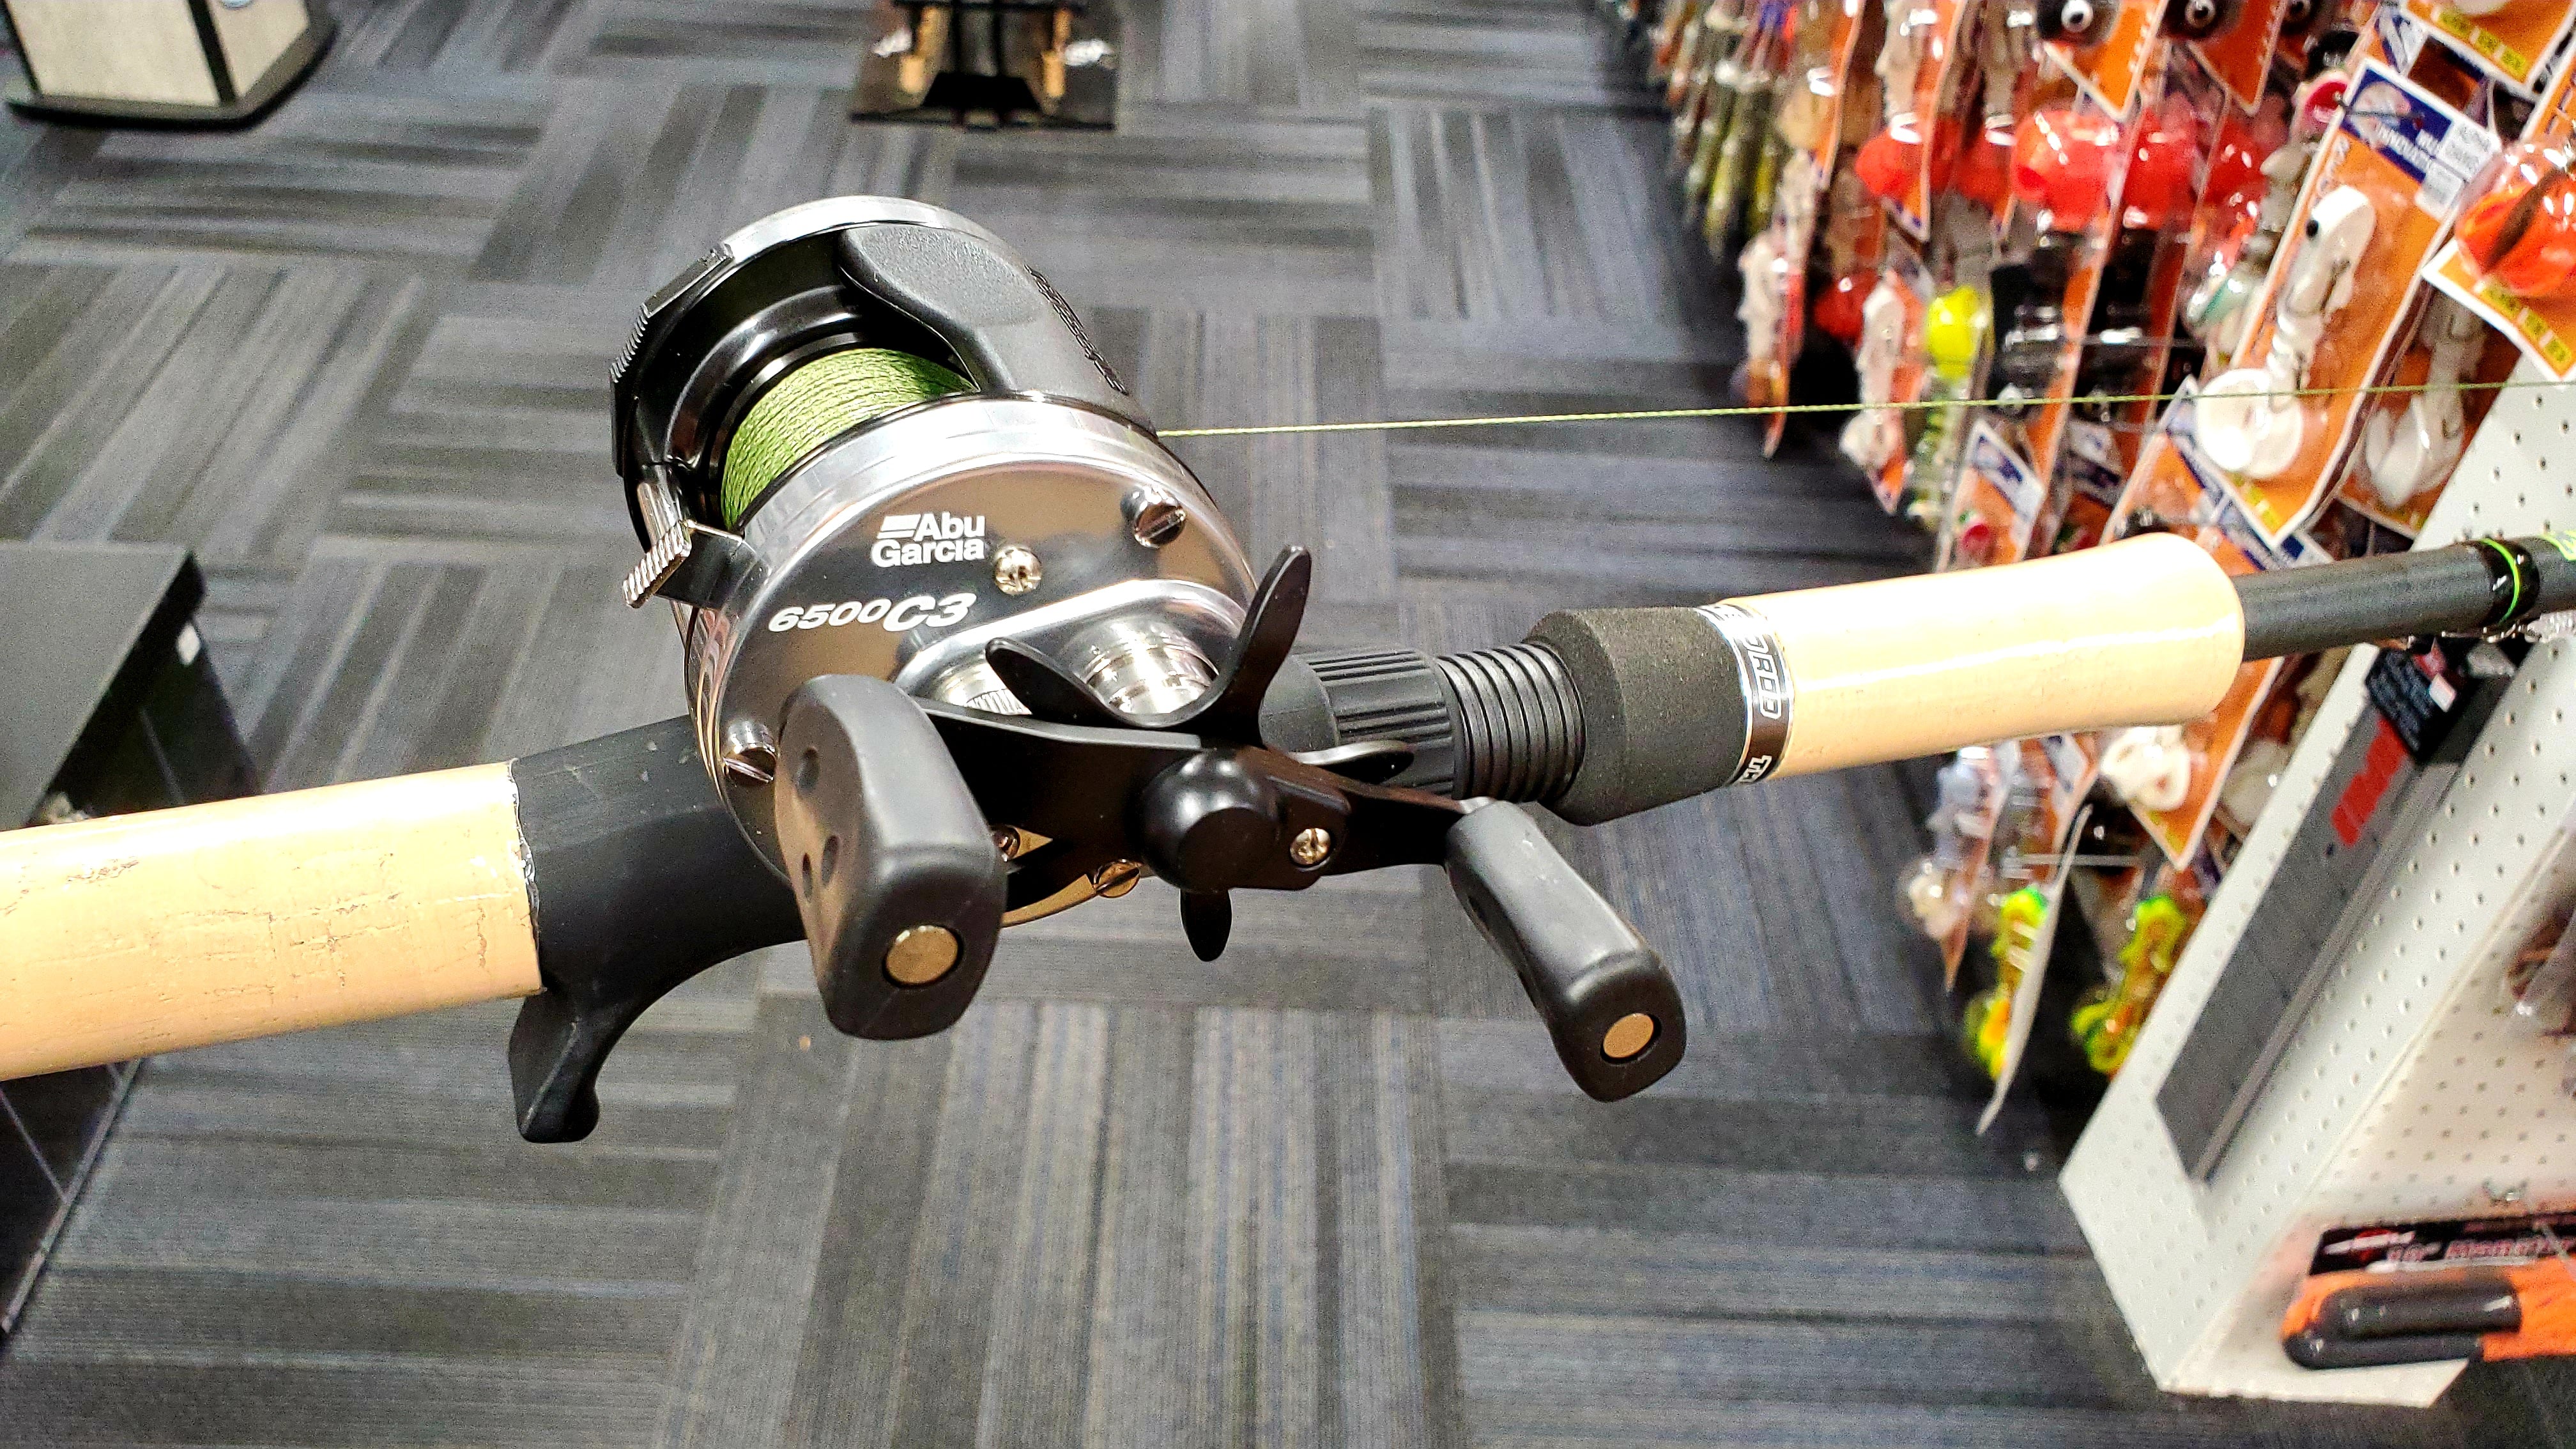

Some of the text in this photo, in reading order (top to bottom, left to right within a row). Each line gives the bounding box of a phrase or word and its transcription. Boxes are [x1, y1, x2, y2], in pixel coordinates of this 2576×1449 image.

[914, 511, 986, 542] Abu
[871, 539, 985, 567] Garcia
[768, 592, 977, 632] 6500C3
